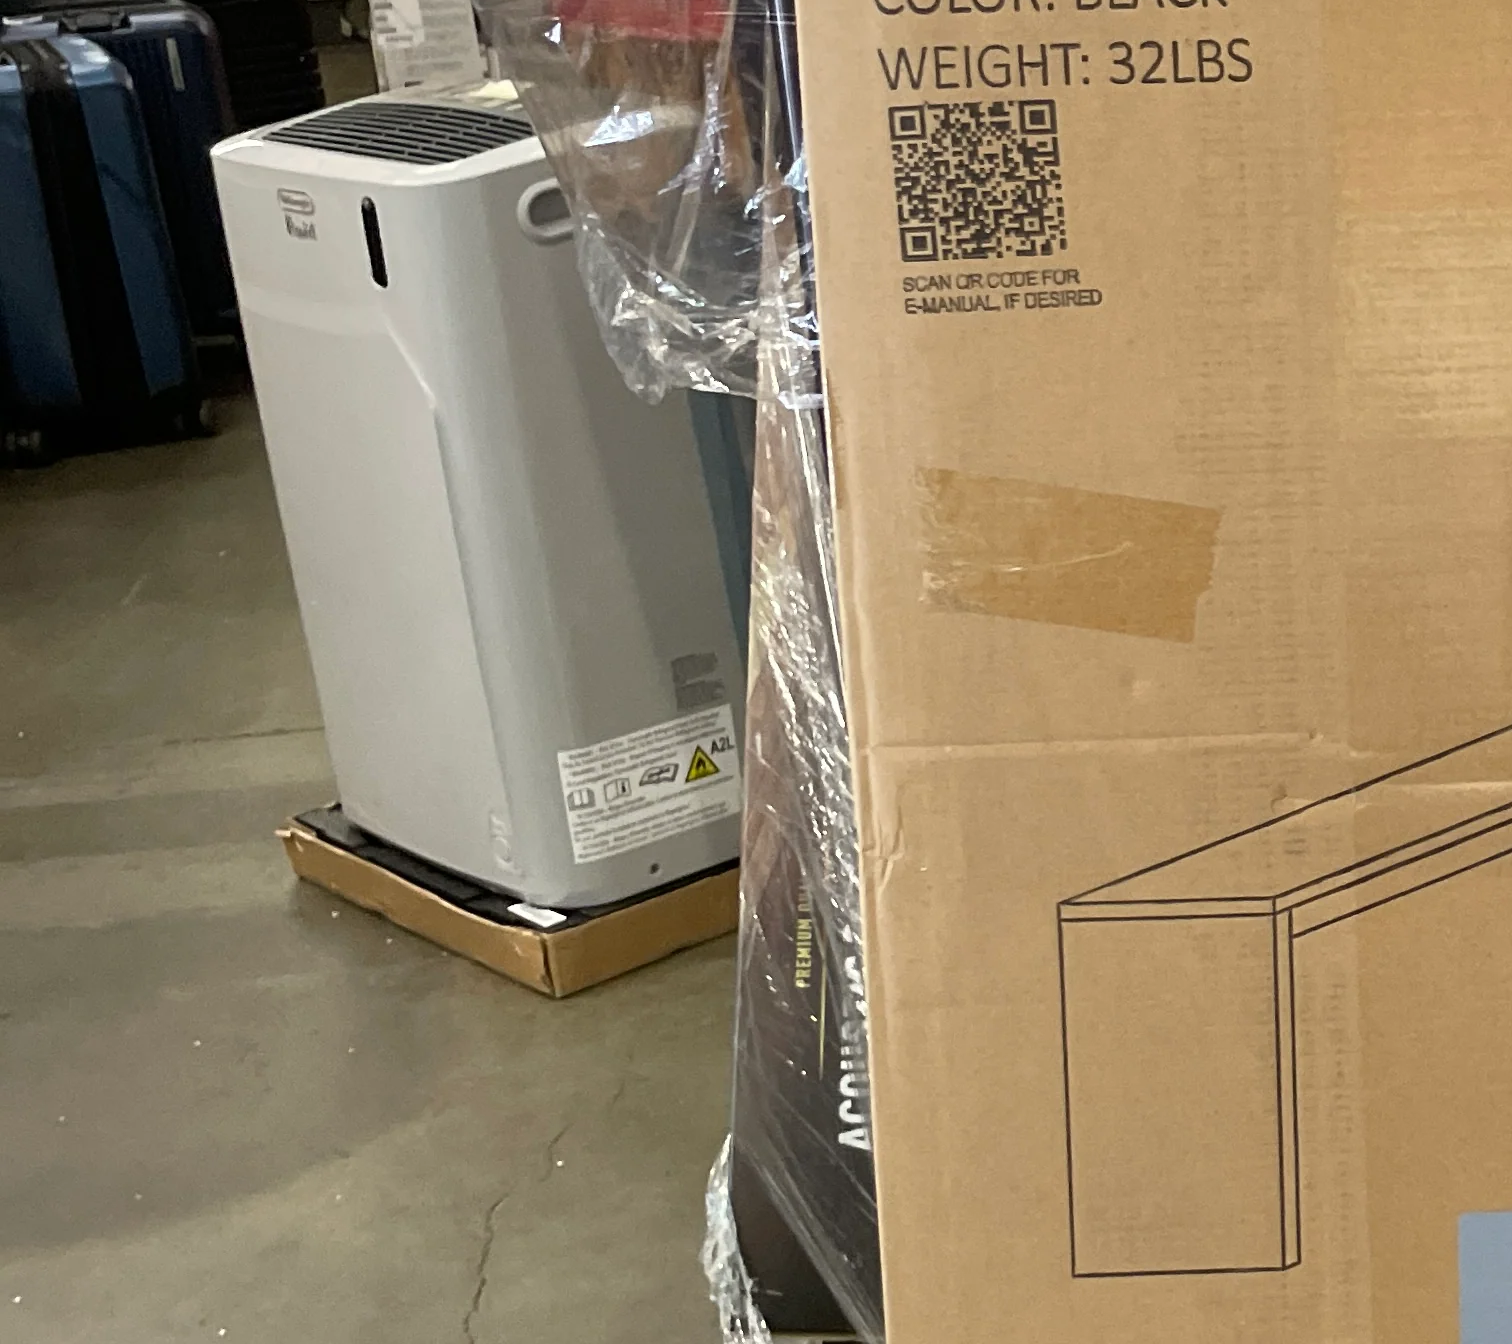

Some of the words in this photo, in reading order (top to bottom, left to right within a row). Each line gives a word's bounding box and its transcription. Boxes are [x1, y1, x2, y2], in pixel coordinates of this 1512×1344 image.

[878, 41, 1090, 91] WEIGHT:
[1107, 37, 1254, 86] 32LBS
[903, 274, 952, 293] SCAN
[987, 270, 1039, 289] CODE
[1042, 268, 1081, 285] FOR
[1003, 293, 1021, 309] IF
[1024, 288, 1103, 309] DESIRED
[711, 736, 735, 755] A2L
[795, 918, 813, 989] PREMIUM
